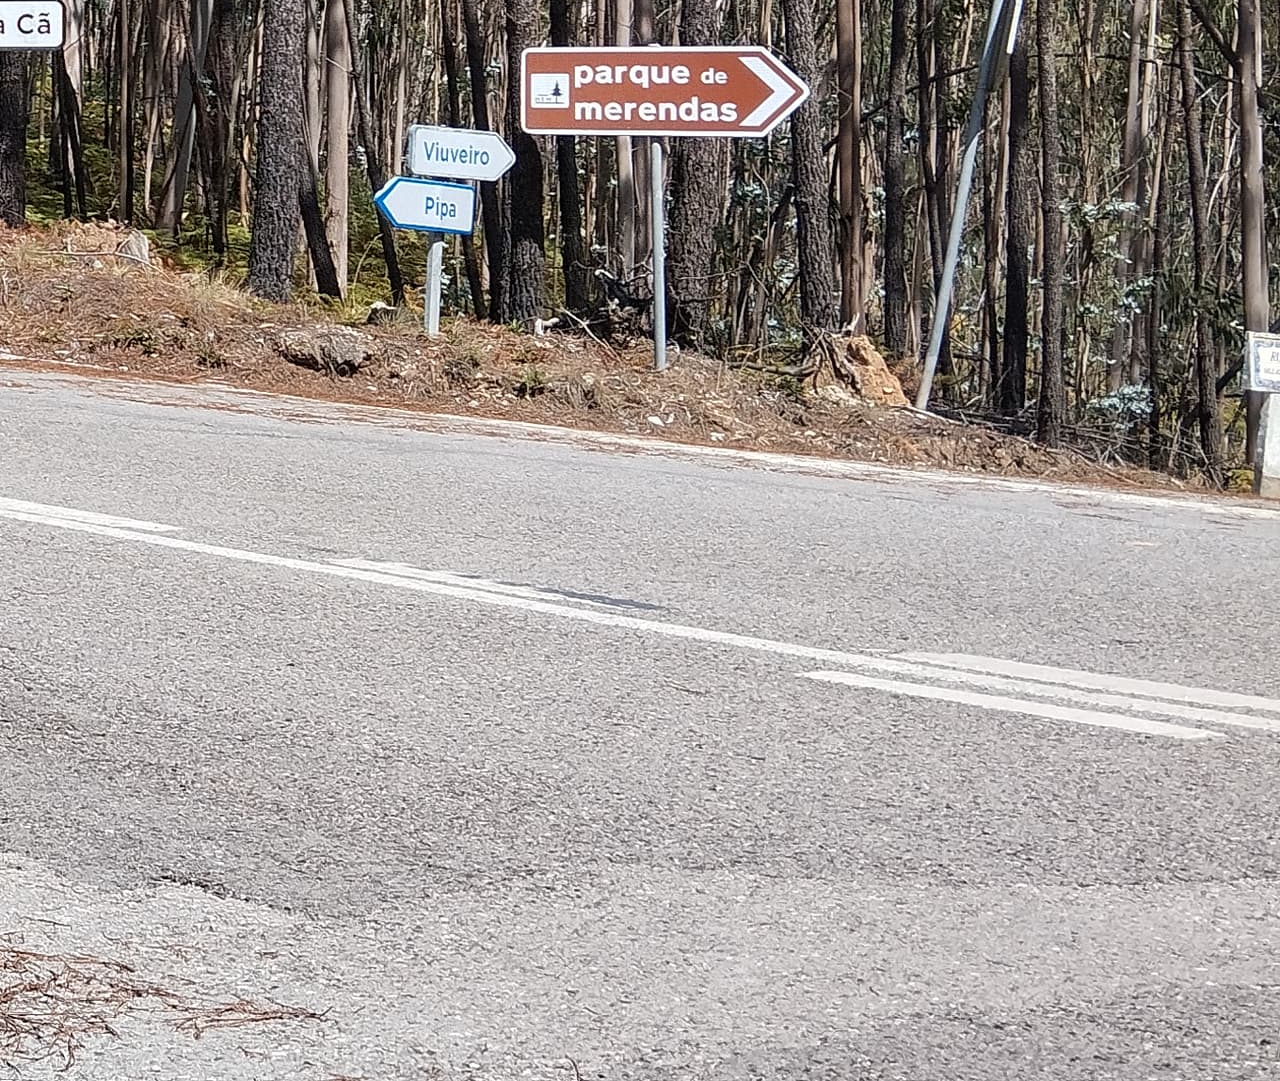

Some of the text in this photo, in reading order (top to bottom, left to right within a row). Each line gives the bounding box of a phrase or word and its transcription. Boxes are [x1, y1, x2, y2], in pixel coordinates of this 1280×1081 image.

[17, 12, 51, 35] Cã
[574, 64, 728, 87] parque de
[574, 96, 737, 122] merendas
[424, 141, 490, 166] Viuveiro
[425, 196, 457, 220] Pipa
